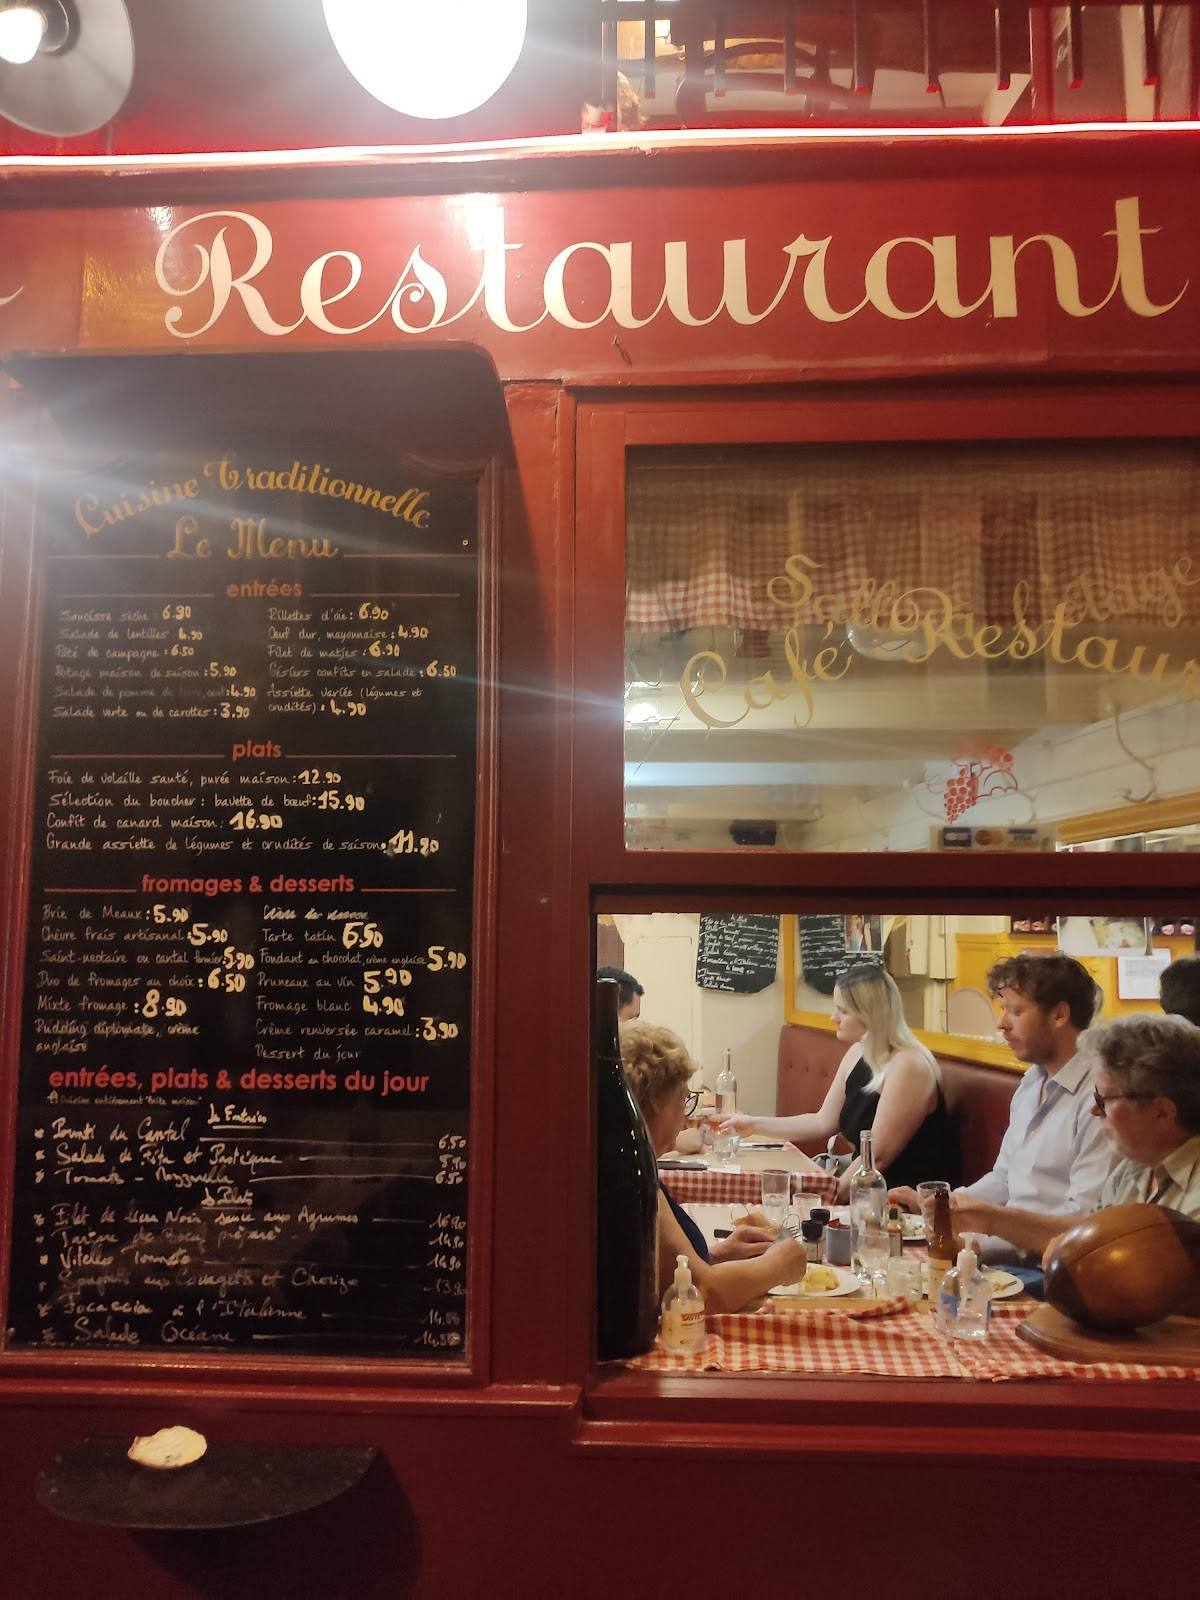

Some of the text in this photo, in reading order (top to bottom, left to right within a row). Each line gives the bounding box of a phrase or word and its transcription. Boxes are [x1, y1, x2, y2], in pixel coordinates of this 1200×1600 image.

[155, 194, 1189, 338] Restaurant
[74, 454, 432, 538] Cuisine Traditionnelle
[166, 515, 339, 560] Le Menu
[227, 579, 303, 599] entrées
[358, 602, 389, 621] 6.90
[107, 628, 119, 640] de
[398, 624, 429, 639] 4.90
[87, 645, 98, 658] de
[300, 646, 313, 658] de
[680, 620, 854, 730] Café
[102, 685, 115, 698] de
[52, 704, 96, 719] Salade
[152, 706, 164, 718] de
[220, 702, 251, 719] 3.90
[232, 740, 282, 761] plats
[47, 769, 73, 785] Foie
[81, 771, 95, 785] de
[101, 770, 143, 785] volaille
[200, 770, 231, 787] purée
[48, 790, 115, 807] Sélection
[123, 794, 141, 807] du
[215, 794, 254, 807] bavette
[261, 795, 275, 807] de
[46, 811, 86, 829] Confit
[94, 814, 107, 829] de
[116, 815, 162, 829] canard
[229, 809, 283, 831] 16.90
[46, 831, 92, 850] Grande
[102, 835, 156, 850] assiette
[166, 837, 178, 850] de
[185, 835, 234, 856] légumes
[242, 837, 253, 850] et
[262, 837, 313, 850] crudités
[322, 838, 335, 850] de
[141, 873, 355, 897] fromages & desserts
[41, 903, 67, 920] Brie
[79, 906, 93, 919] de
[85, 926, 117, 941] frais
[262, 928, 295, 942] Tarte
[304, 929, 337, 942] tatin
[155, 951, 189, 964] cantal
[259, 948, 304, 964] Fondant
[427, 945, 467, 972] 5.90
[36, 970, 60, 986] Duo
[68, 973, 80, 986] de
[88, 973, 141, 991] fromages
[207, 967, 246, 993] 6.50
[256, 967, 412, 994] Pruneaux au vin 5.90
[37, 995, 72, 1011] Mixte
[78, 996, 128, 1016] fromage
[255, 995, 405, 1017] Fromage blanc 4.90
[33, 1017, 87, 1039] Pudding
[167, 1021, 201, 1035] crème
[255, 1018, 292, 1036] Crème
[300, 1020, 358, 1036] renversée
[35, 1039, 89, 1056] anglaise
[254, 1043, 363, 1064] Dessert du jour
[49, 1065, 430, 1097] entrées, plats & desserts du jour
